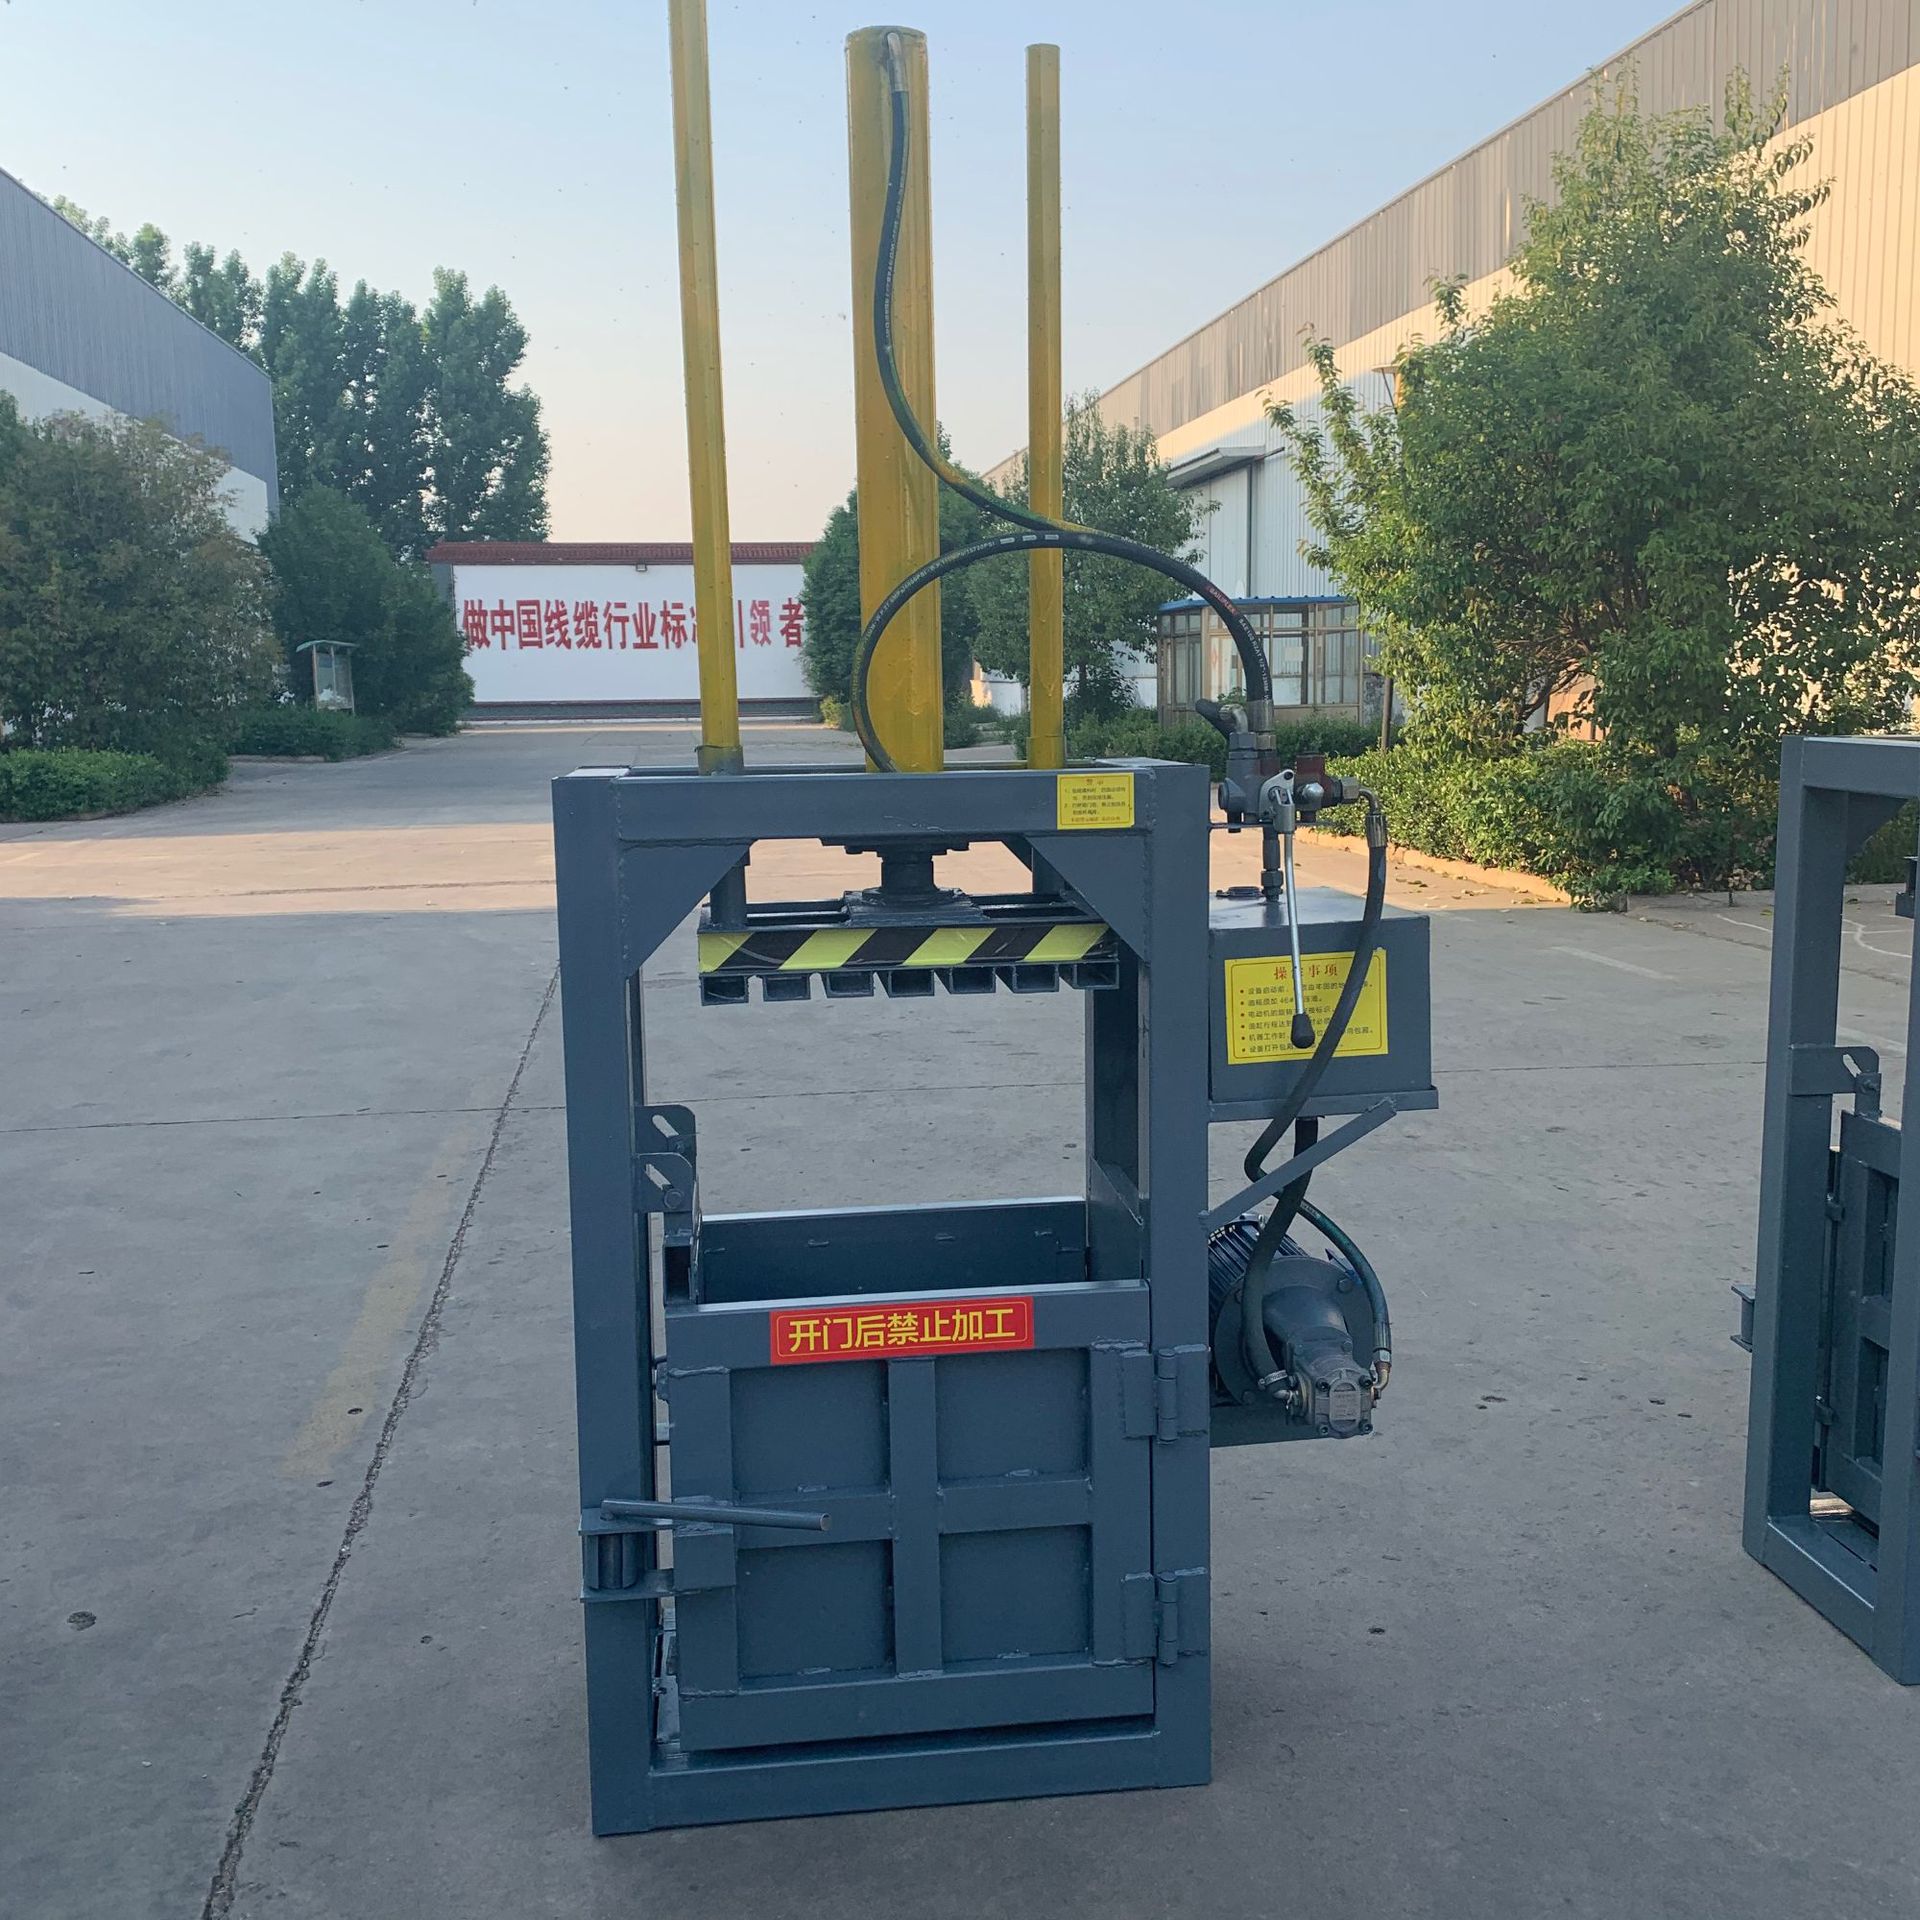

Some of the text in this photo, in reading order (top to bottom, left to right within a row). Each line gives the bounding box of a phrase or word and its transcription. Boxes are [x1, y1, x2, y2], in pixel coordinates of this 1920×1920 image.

[463, 597, 804, 650] 做中国线缆行业标领者
[1273, 964, 1338, 980] 操事项
[788, 1308, 1016, 1352] 开门后禁止加工
